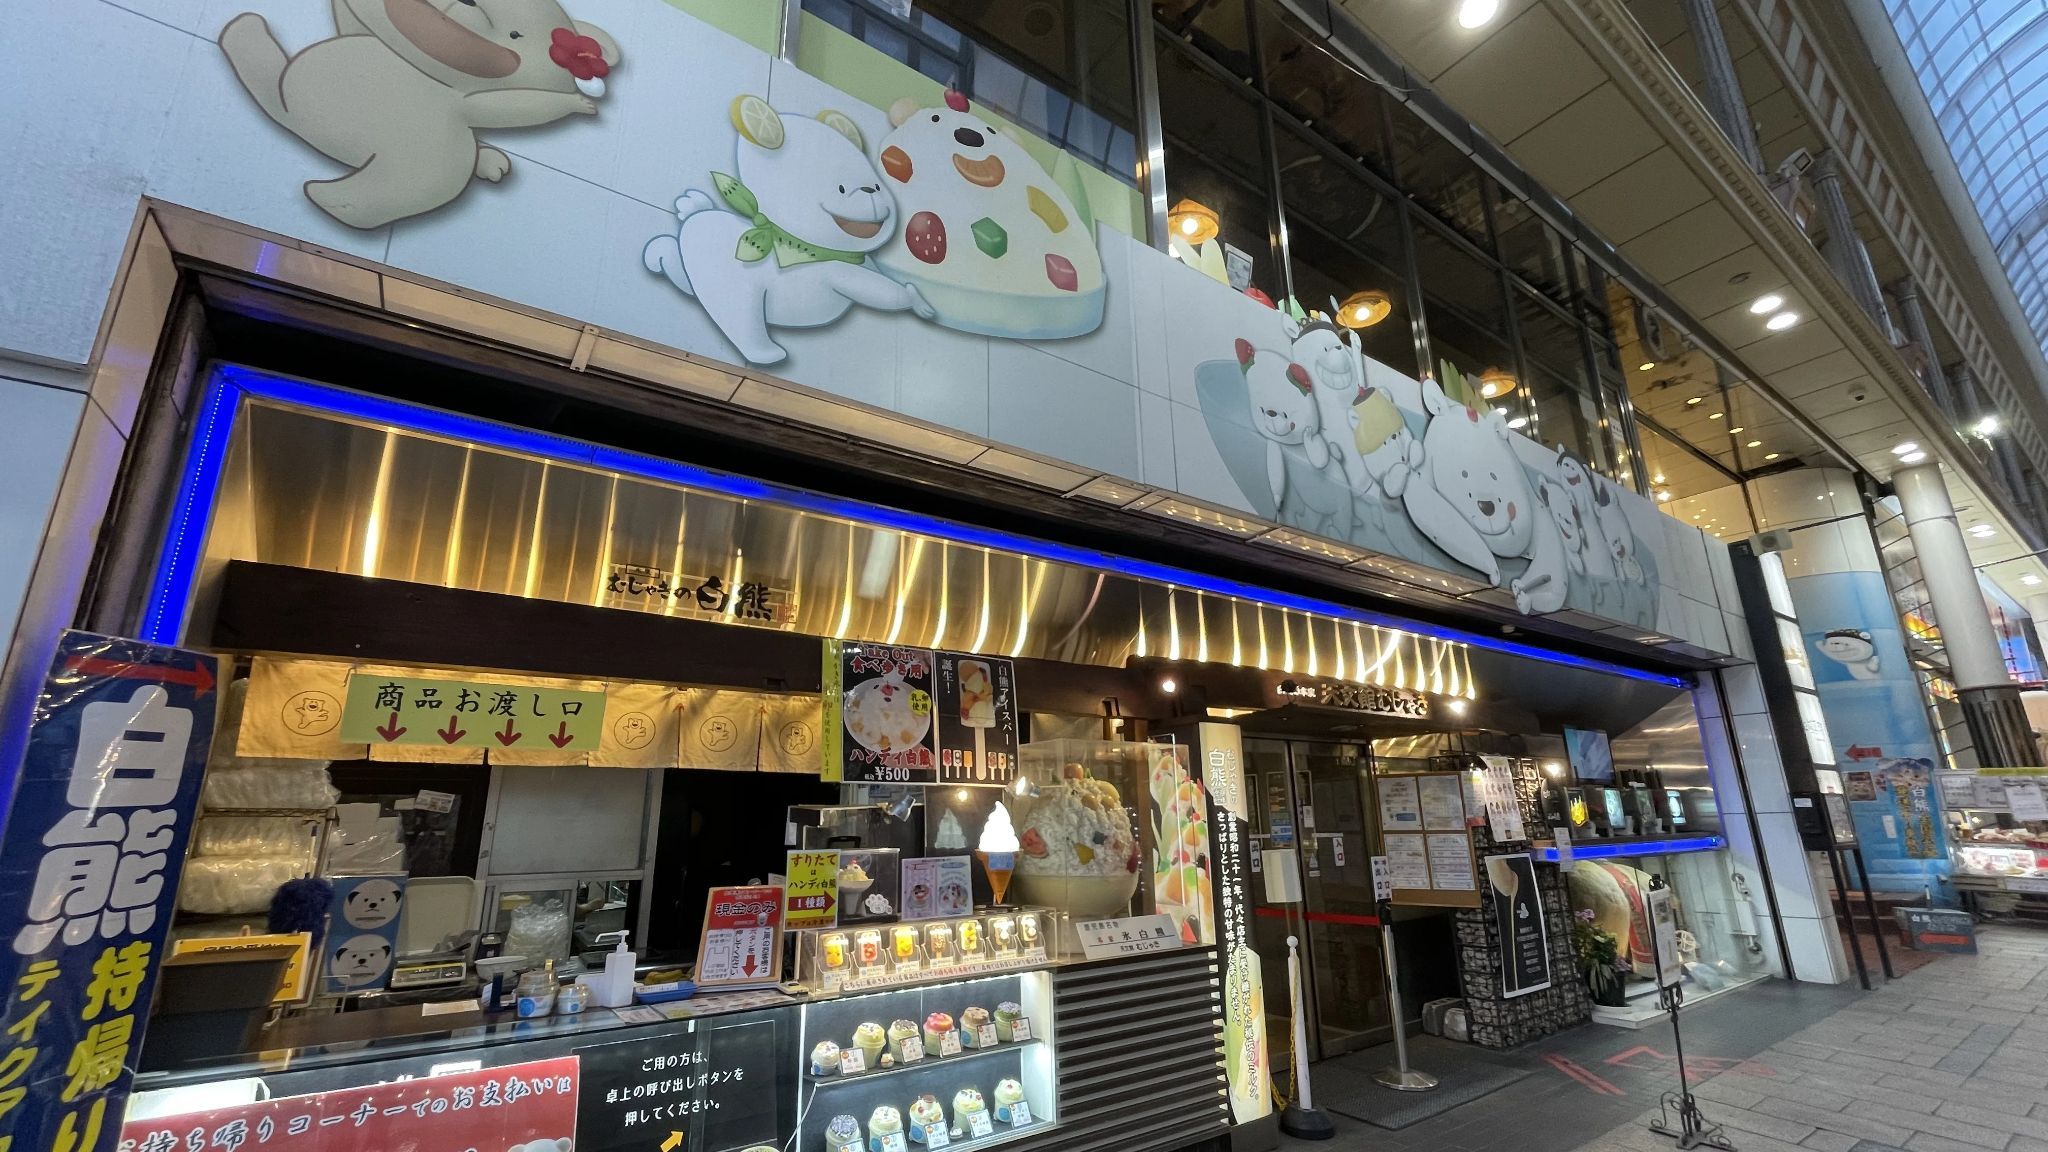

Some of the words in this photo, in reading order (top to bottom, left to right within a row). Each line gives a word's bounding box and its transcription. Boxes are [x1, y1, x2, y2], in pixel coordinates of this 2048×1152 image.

[850, 655, 923, 680] 食べ歩き用
[374, 681, 584, 717] 商品お渡し口
[875, 766, 910, 781] ¥500
[1208, 748, 1227, 787] 白熊
[12, 684, 194, 956] 白熊
[791, 854, 837, 868] すりたて
[715, 900, 777, 917] 現金のみ
[642, 1050, 709, 1072] ご用の方は、
[605, 1067, 744, 1104] 卓上の呼び出しボタンを
[624, 1098, 720, 1127] 押してください。
